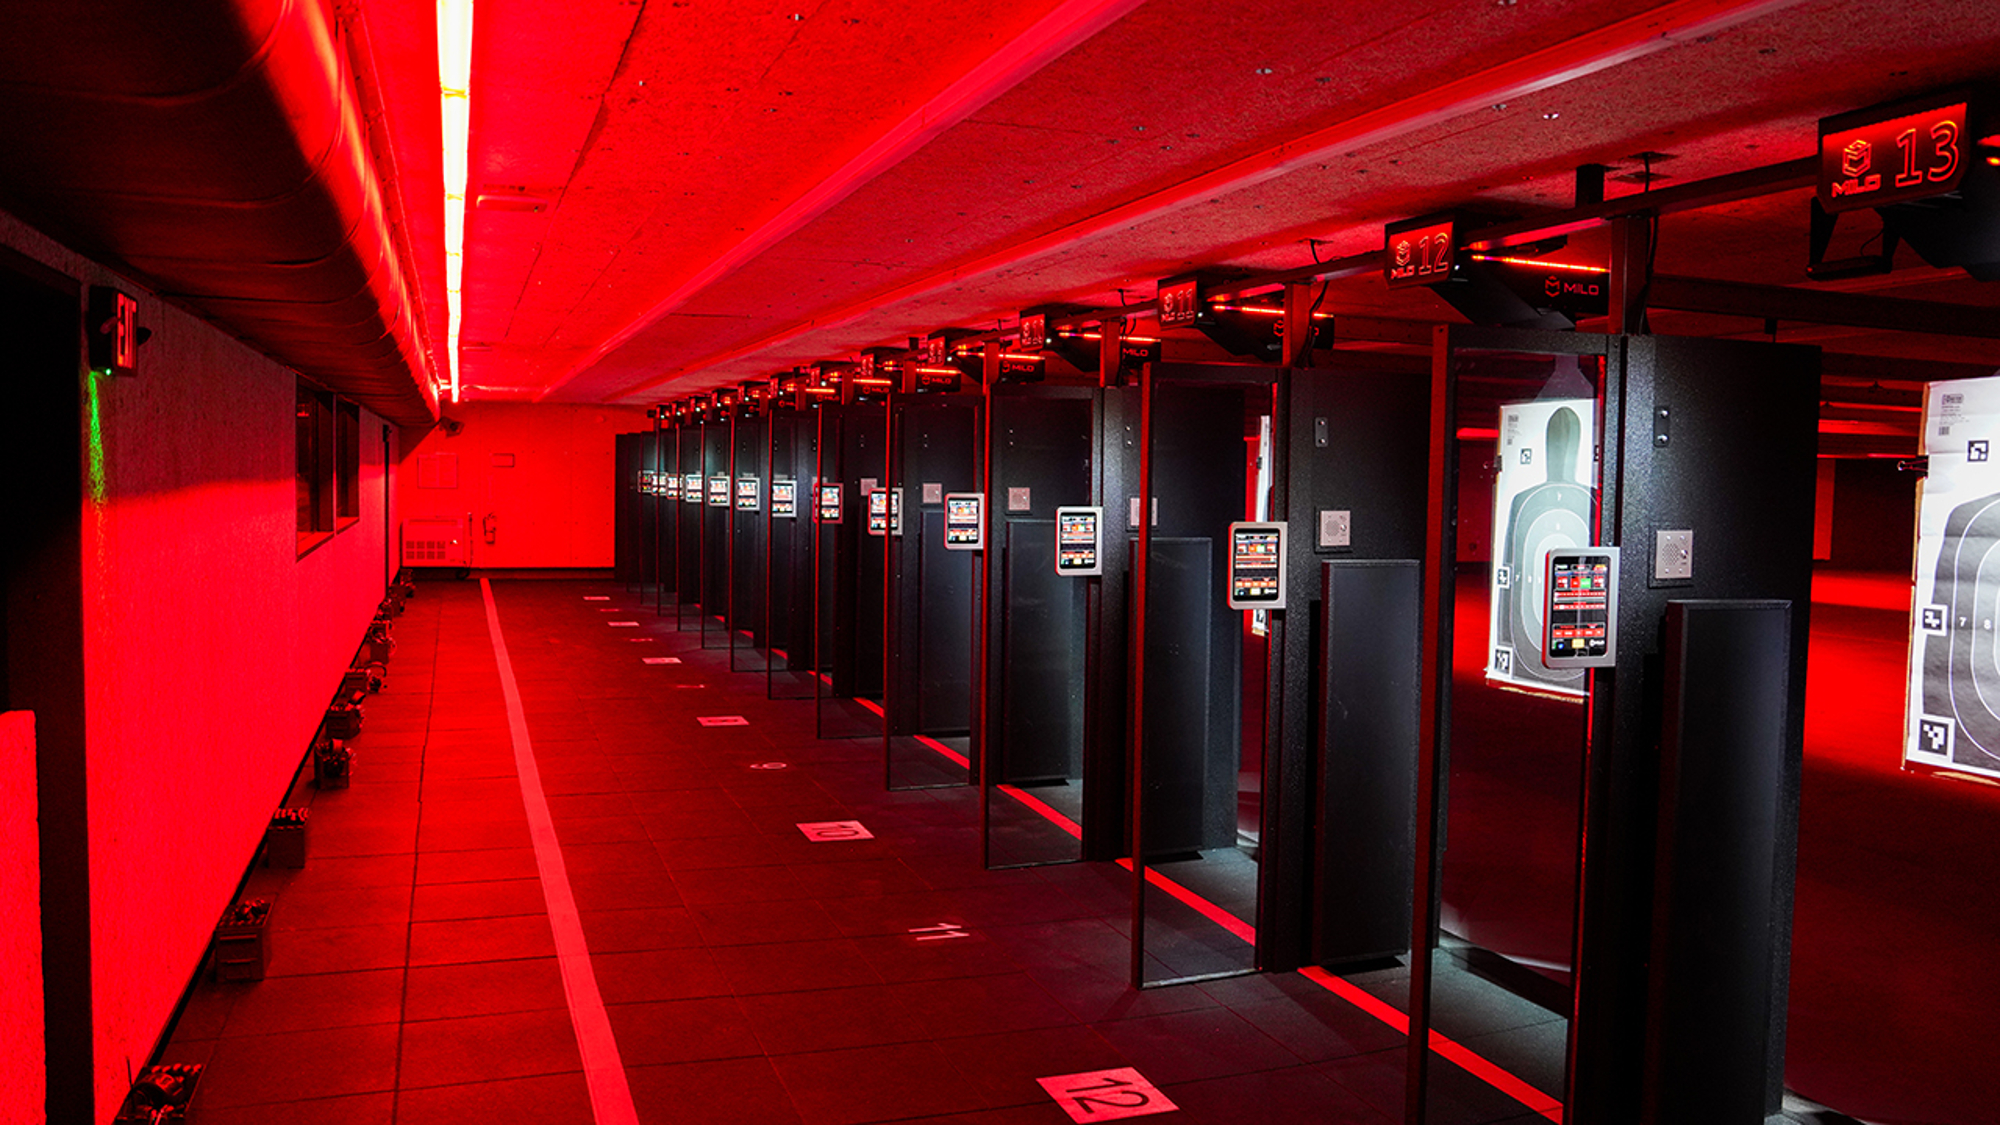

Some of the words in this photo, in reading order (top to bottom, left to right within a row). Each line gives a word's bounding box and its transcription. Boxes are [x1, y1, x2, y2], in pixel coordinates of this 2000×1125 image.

[1895, 120, 1960, 188] 13
[1831, 174, 1881, 197] MILO
[1418, 232, 1449, 276] 12
[1390, 265, 1415, 280] MILO
[1563, 282, 1600, 296] MILO
[1176, 288, 1195, 320] 11
[1122, 347, 1149, 357] MILO
[1011, 364, 1035, 373] MILO
[1958, 616, 1968, 628] 7
[1983, 619, 1992, 631] 8
[811, 824, 860, 838] 10
[908, 922, 970, 941] 11
[1065, 1077, 1150, 1115] 12
